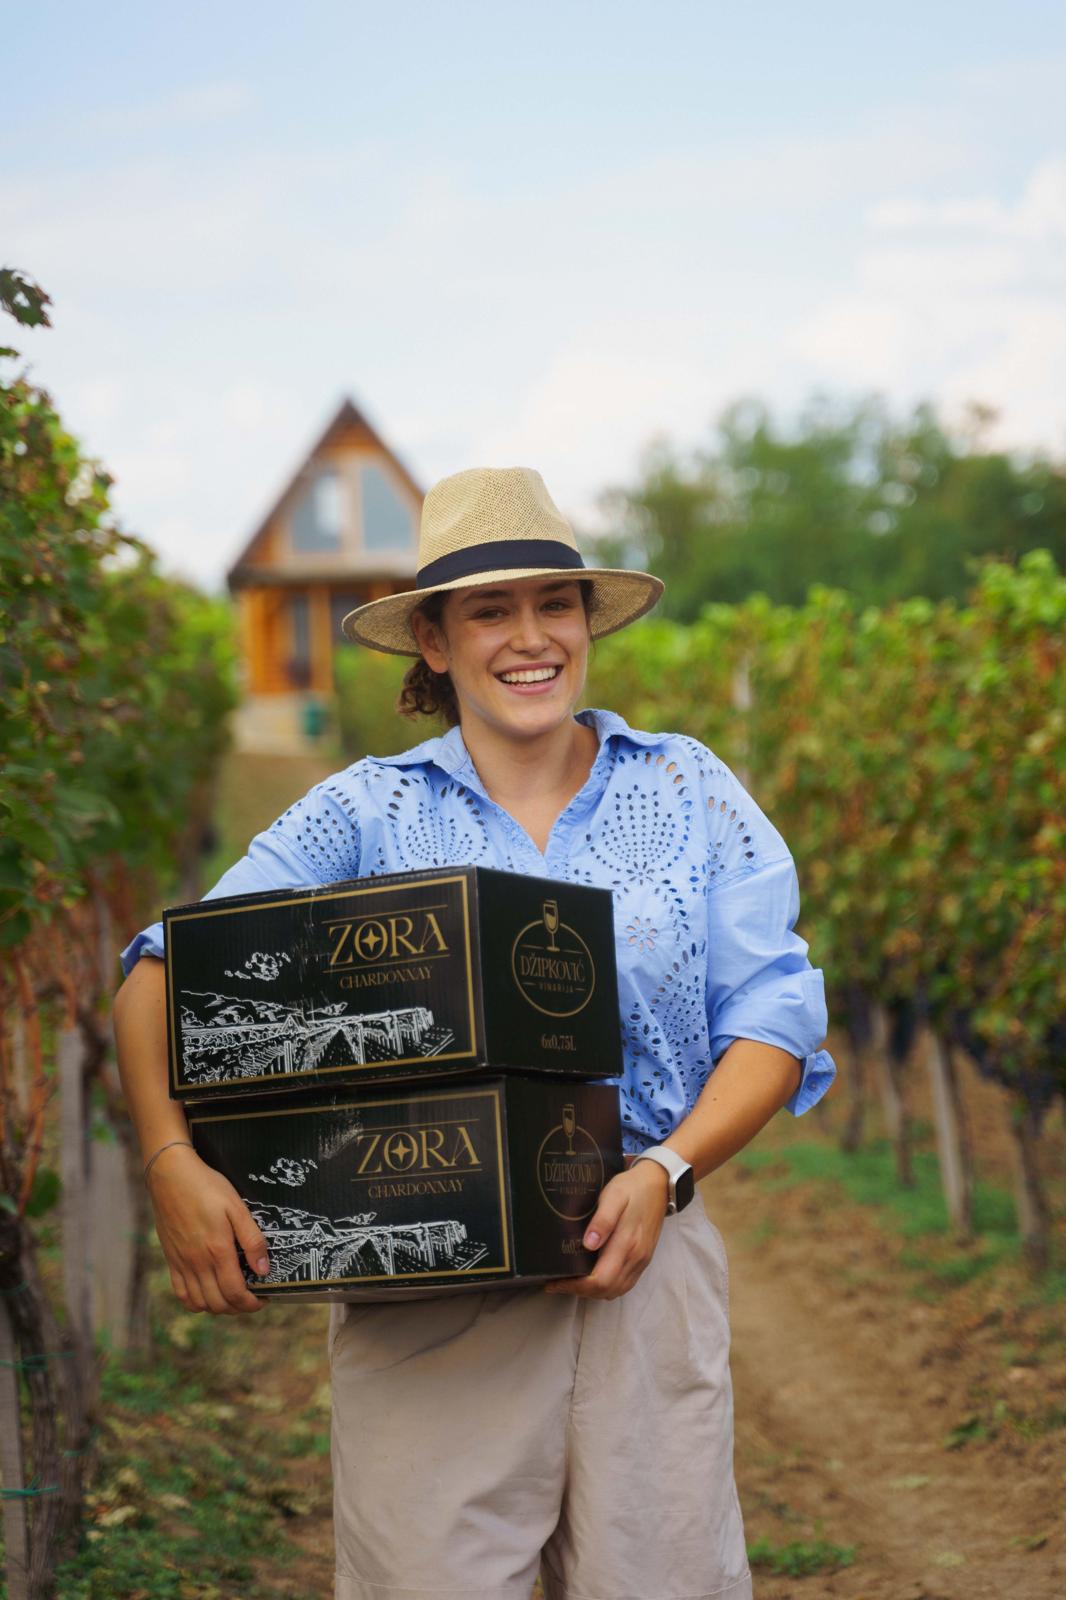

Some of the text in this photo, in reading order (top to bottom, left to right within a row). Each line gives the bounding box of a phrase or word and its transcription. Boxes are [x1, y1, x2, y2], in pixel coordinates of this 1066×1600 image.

[329, 913, 448, 966] ZORA
[340, 966, 432, 989] CHARDONNAY
[357, 1127, 481, 1174] ZORA
[368, 1178, 464, 1199] CHARDONNAY
